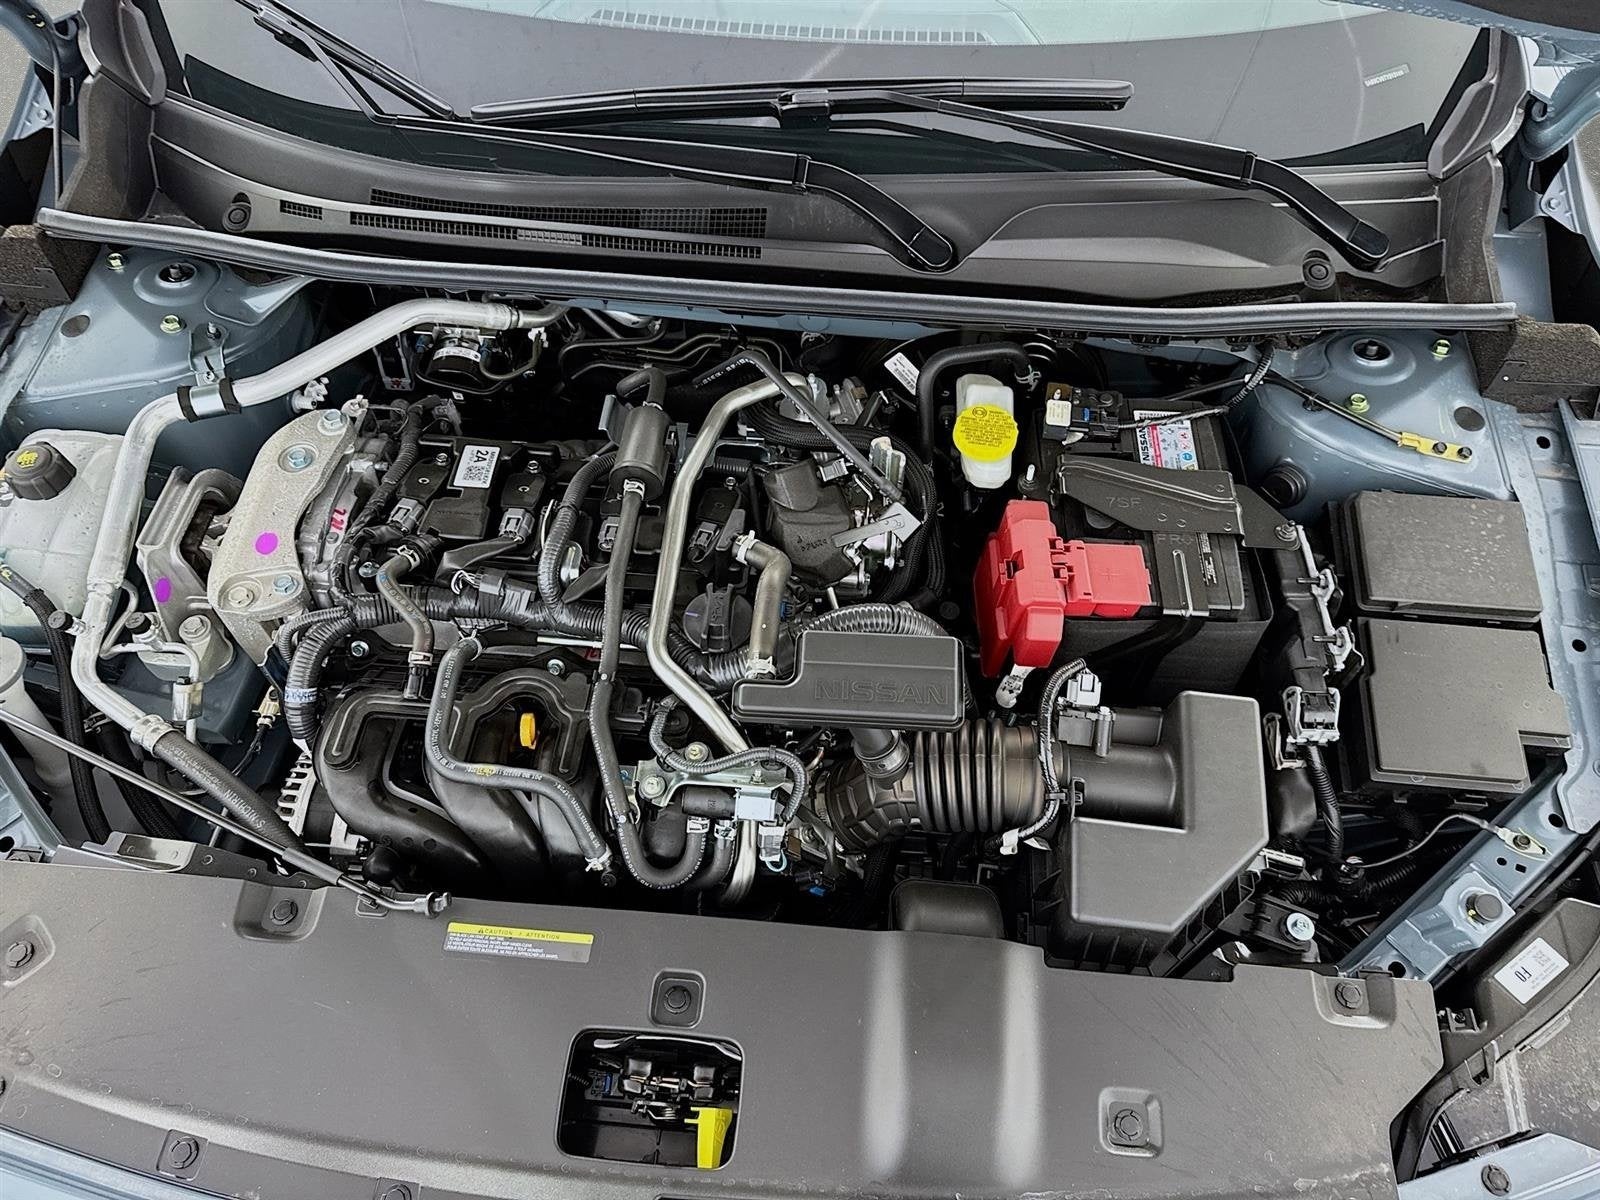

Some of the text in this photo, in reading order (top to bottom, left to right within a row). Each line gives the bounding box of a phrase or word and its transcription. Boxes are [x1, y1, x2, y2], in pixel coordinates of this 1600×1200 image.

[1139, 426, 1150, 461] NISSAN
[473, 449, 489, 463] 2A
[814, 679, 949, 705] NISSAN
[484, 928, 513, 936] CAUTION
[526, 932, 560, 940] ATTENTION
